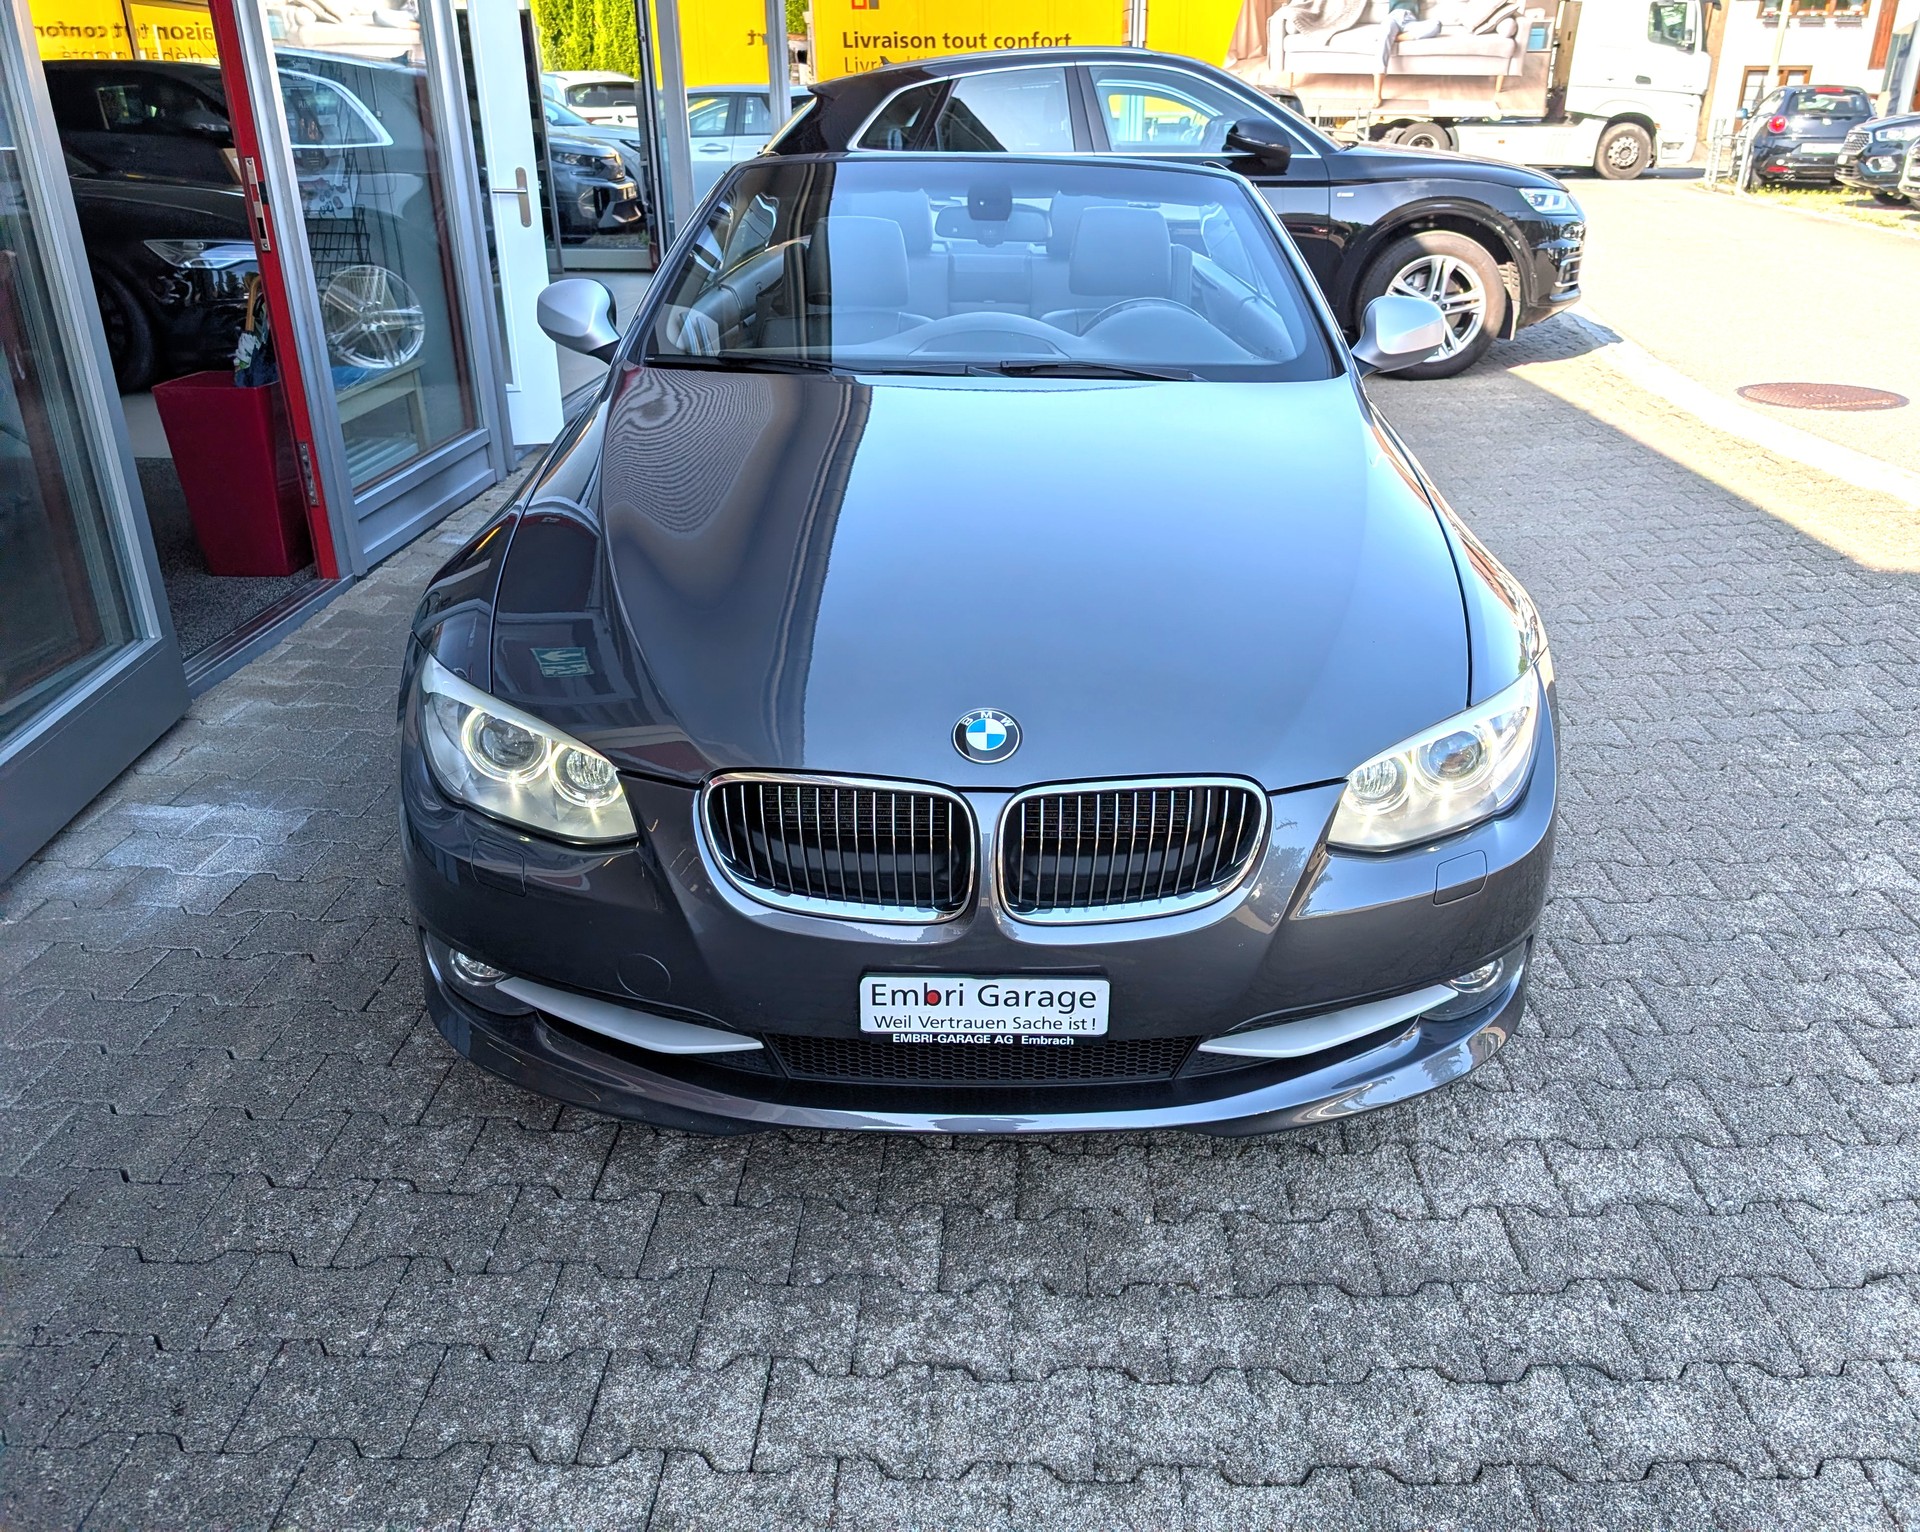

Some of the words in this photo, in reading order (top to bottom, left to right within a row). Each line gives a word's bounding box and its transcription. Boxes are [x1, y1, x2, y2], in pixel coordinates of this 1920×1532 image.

[842, 31, 937, 49] Livraison
[943, 32, 988, 49] tout
[993, 31, 1072, 50] confort
[844, 56, 883, 74] Livr
[961, 710, 1014, 727] BMW
[871, 982, 964, 1007] Embri
[977, 984, 1097, 1015] Garage
[873, 1014, 912, 1029] Weil
[918, 1015, 1007, 1029] Vertrauen
[1012, 1016, 1063, 1030] Sache
[1068, 1016, 1087, 1030] ist
[892, 1033, 991, 1044] EMBRI-GARAGE
[993, 1034, 1014, 1044] AG
[1021, 1035, 1075, 1046] Embrach
